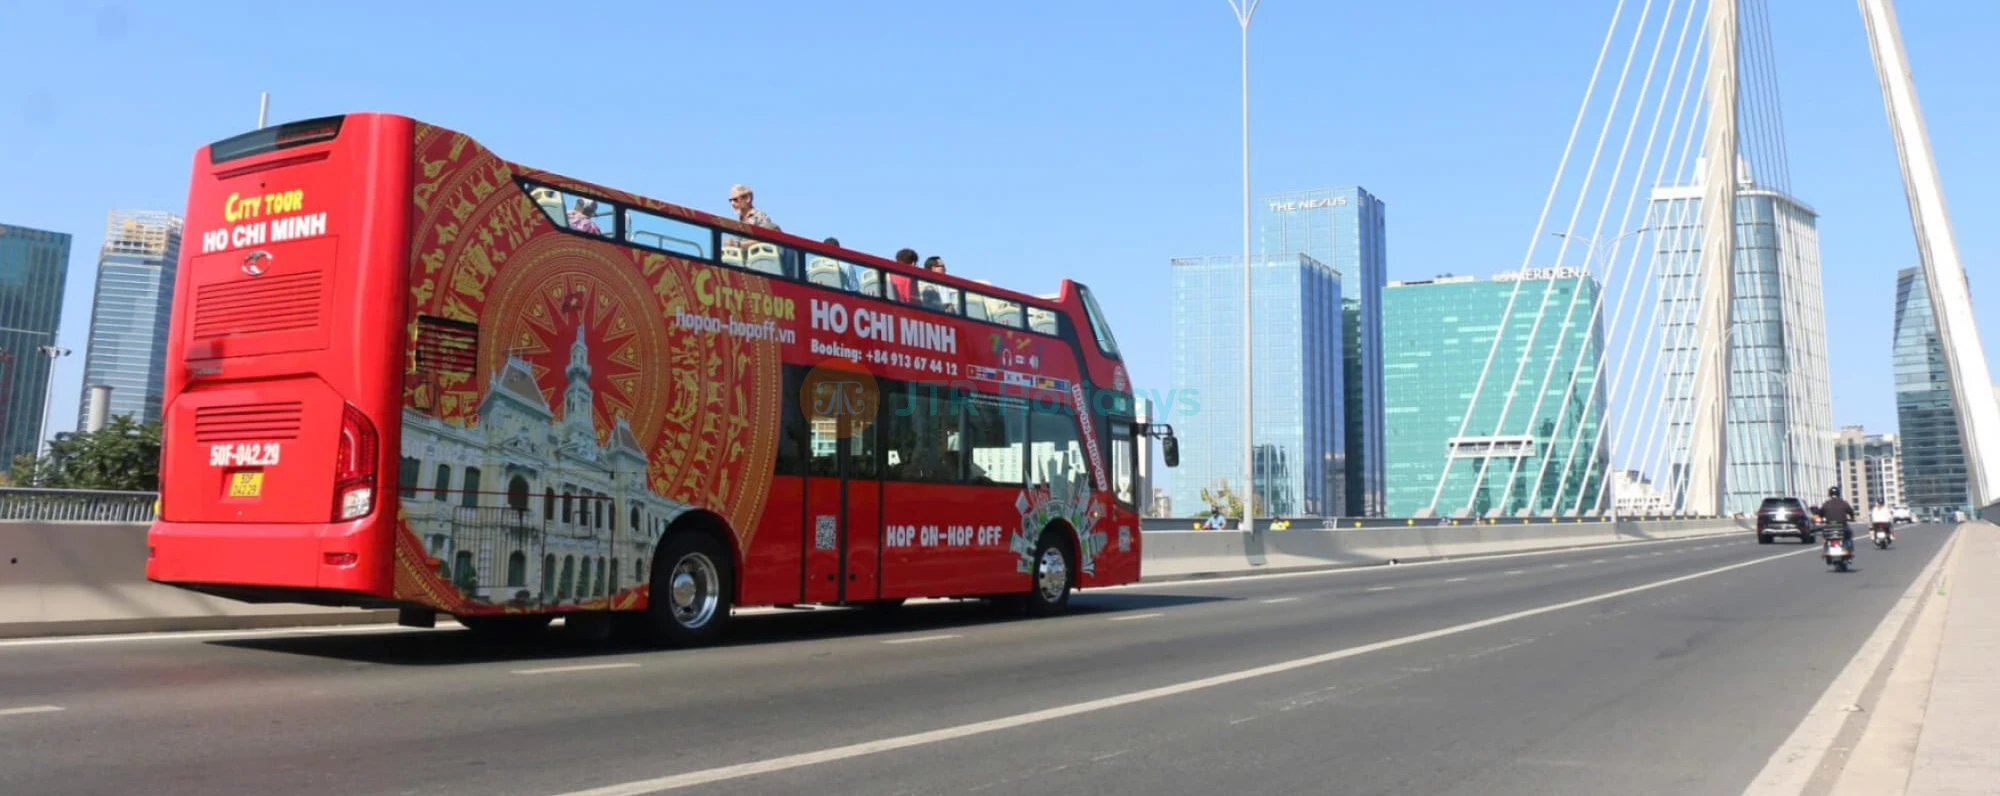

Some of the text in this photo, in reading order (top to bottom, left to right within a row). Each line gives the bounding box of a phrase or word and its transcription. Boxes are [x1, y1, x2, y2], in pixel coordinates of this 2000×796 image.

[265, 190, 303, 215] TOUR
[1269, 196, 1347, 211] THE NEXUS
[202, 212, 327, 253] HO CHI MINH
[751, 292, 795, 320] TOUR
[676, 306, 796, 344] hopon-hopoff.vn
[811, 299, 957, 354] HO CHI MINH
[811, 339, 958, 376] Booking: +84 913 67 44 12
[209, 443, 280, 467] 50F-042.29
[886, 525, 1002, 547] HOP ON-HOP OFF
